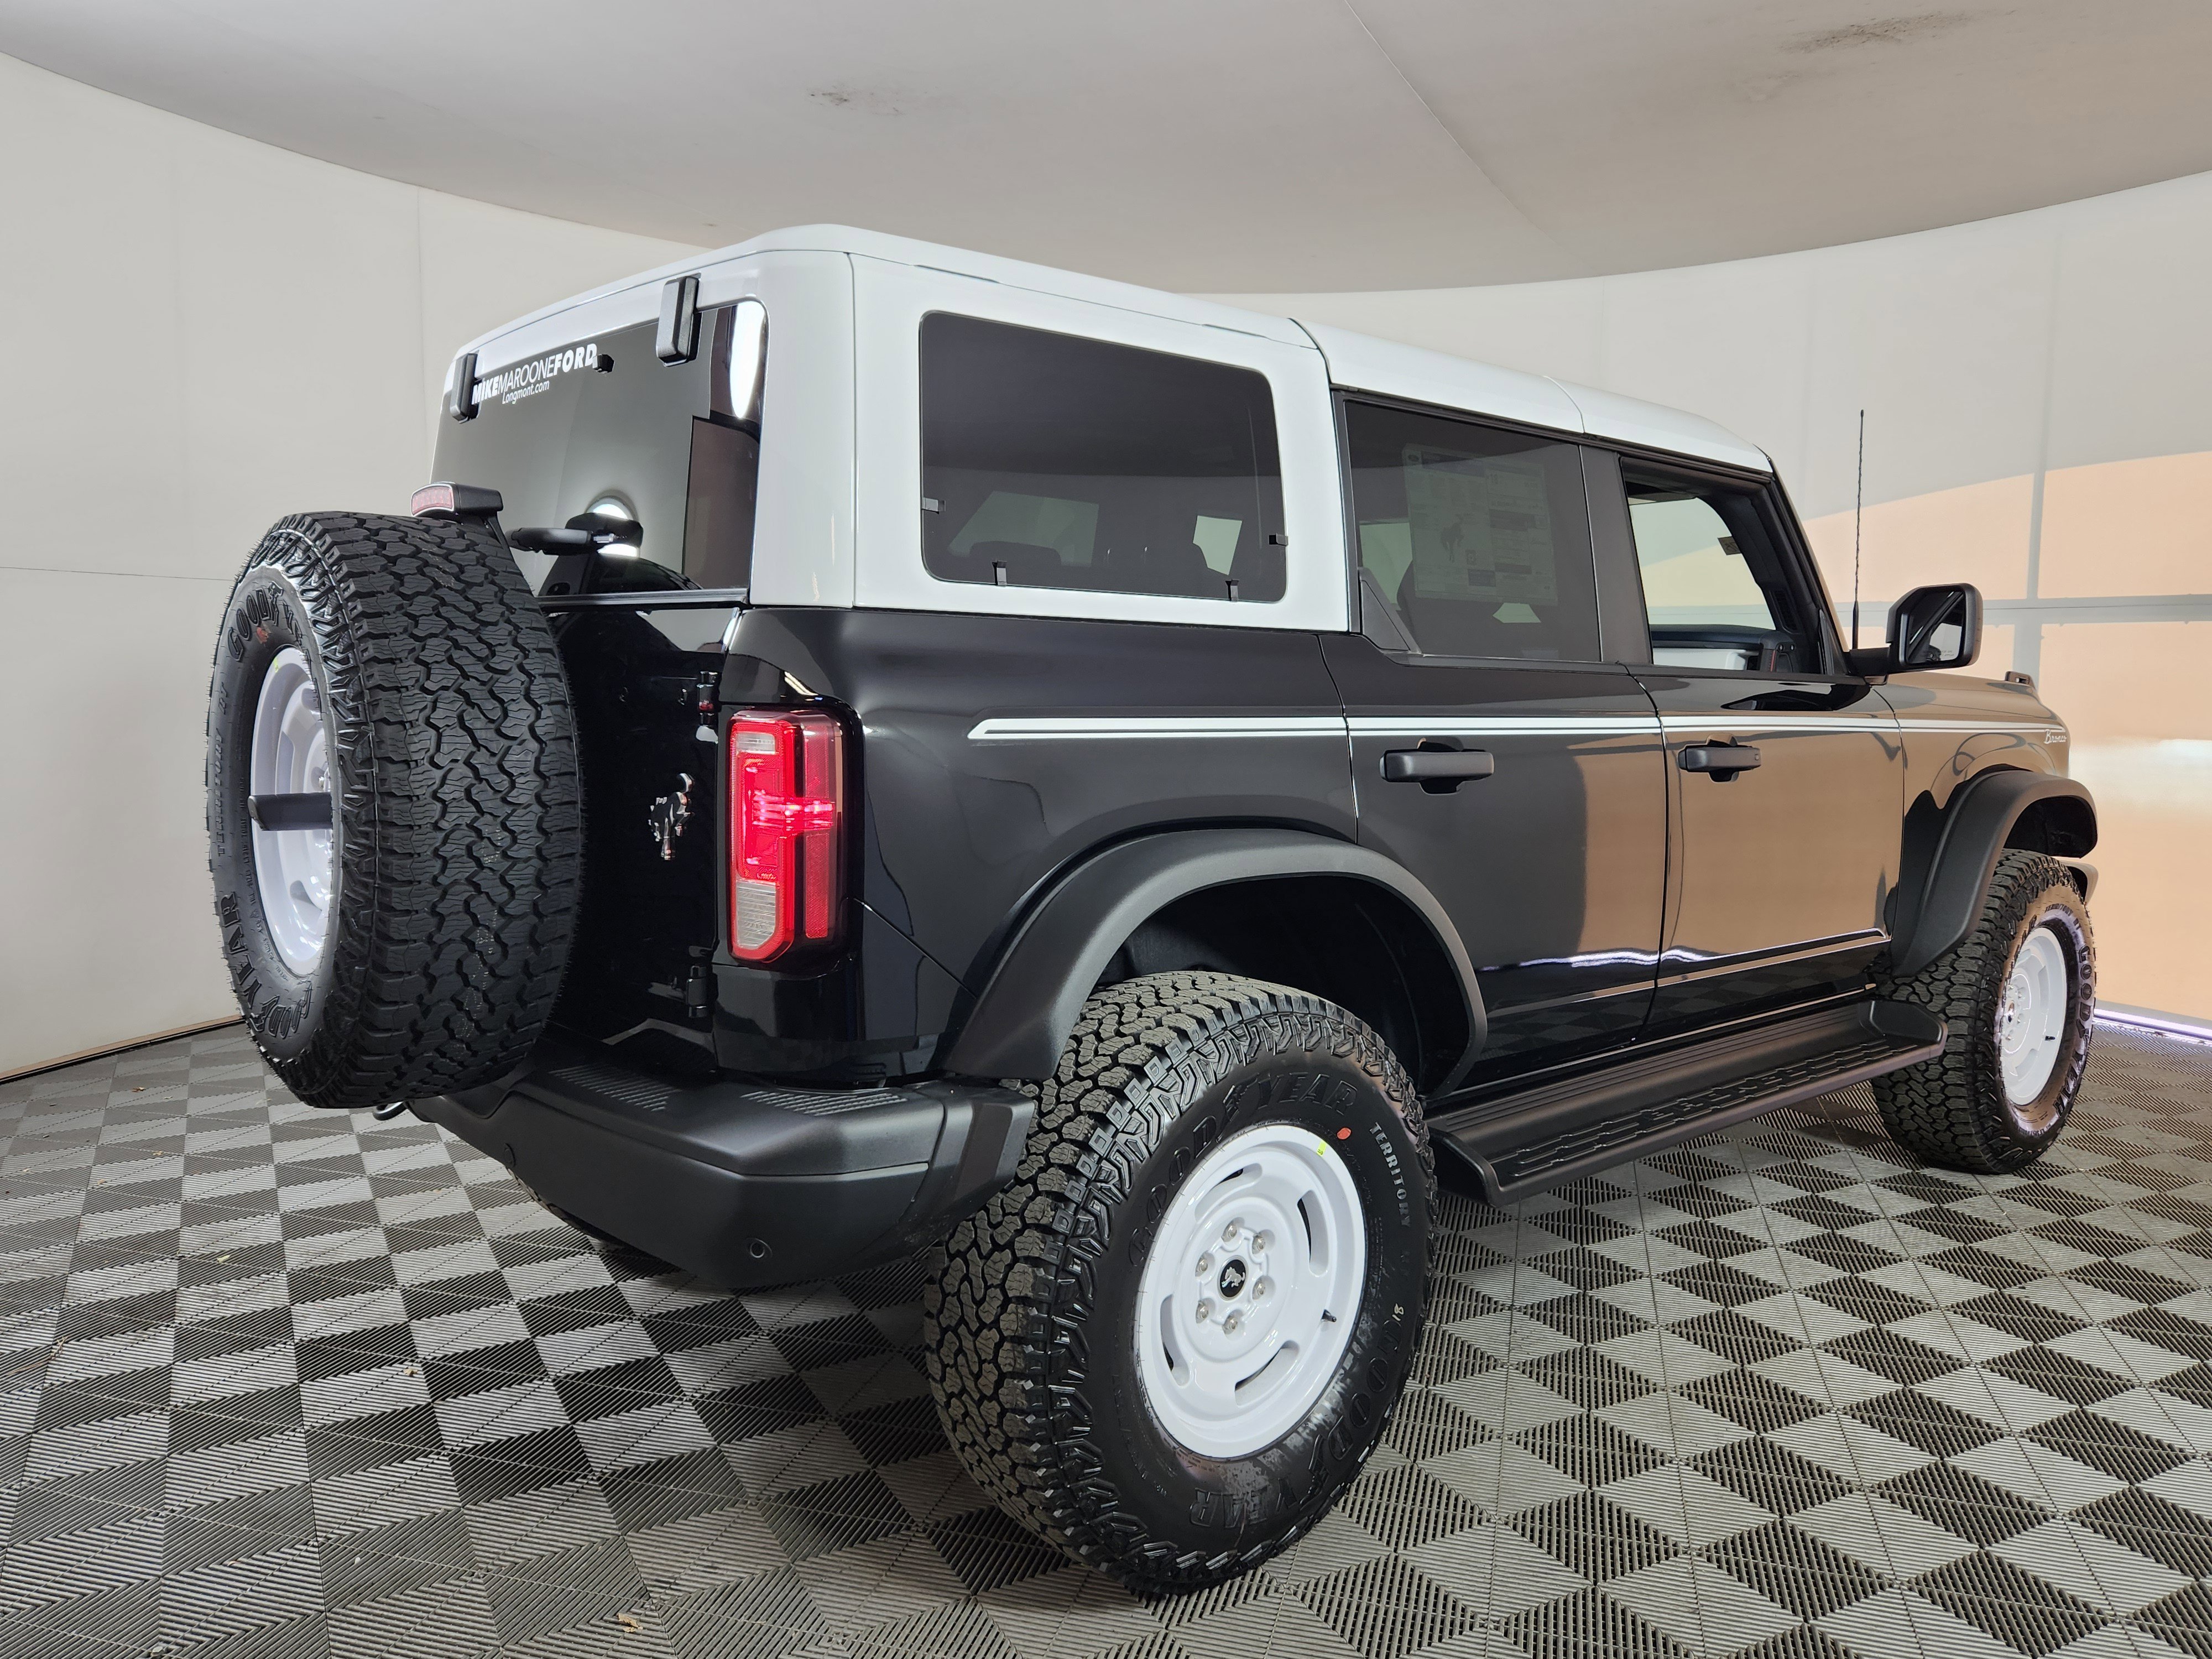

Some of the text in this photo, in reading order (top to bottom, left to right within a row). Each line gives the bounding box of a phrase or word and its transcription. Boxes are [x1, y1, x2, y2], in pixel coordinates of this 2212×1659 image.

[502, 380, 549, 404] Longmont.com
[2043, 729, 2067, 744] Bronco
[214, 727, 226, 857] TERRITORY
[1129, 1071, 1358, 1266] GOODYEAR
[1369, 1121, 1411, 1228] TERRITORY
